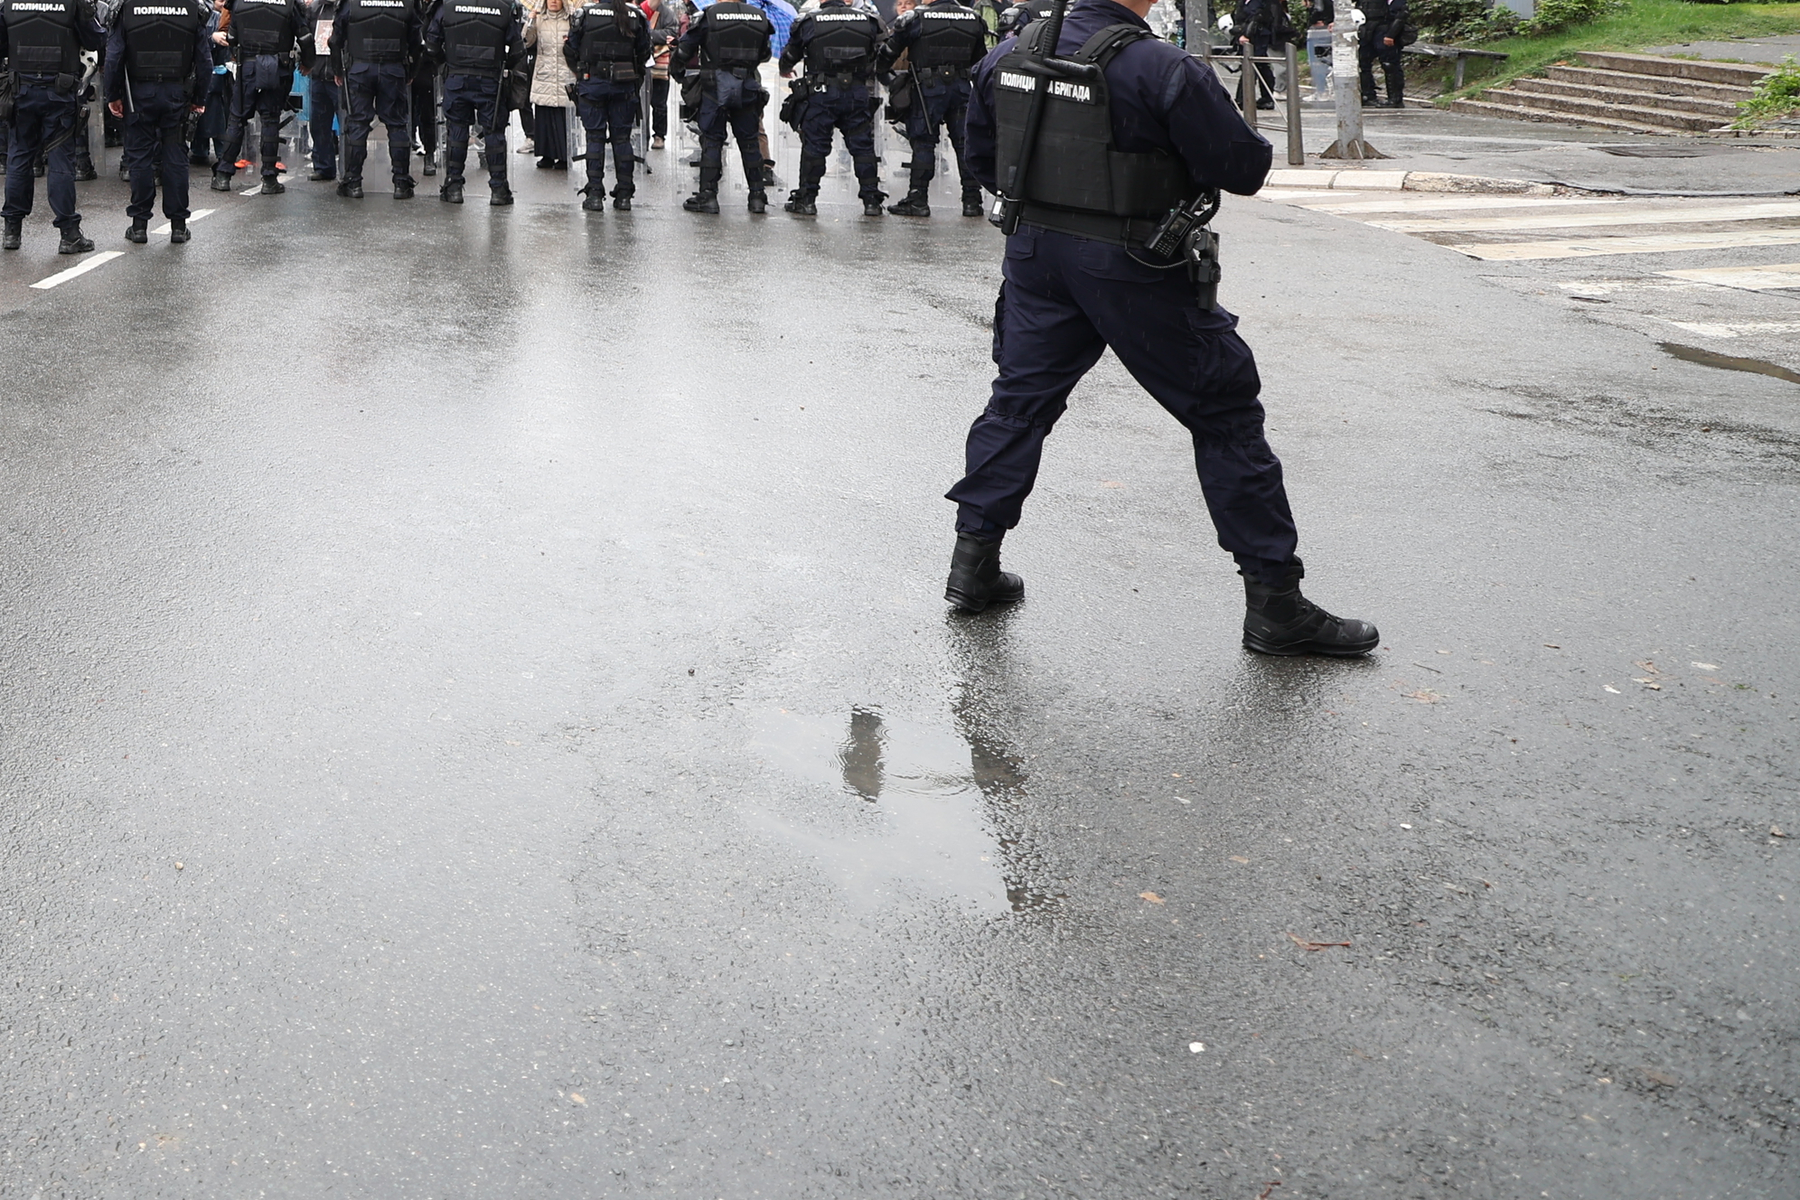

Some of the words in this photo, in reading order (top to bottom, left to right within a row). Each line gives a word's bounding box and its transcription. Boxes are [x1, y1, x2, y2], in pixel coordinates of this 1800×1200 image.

[11, 2, 66, 12] ПОЛИЦИЈА
[360, 0, 404, 8] ПОЛИЦИЈА
[133, 6, 188, 16] ПОЛИЦИЈА
[454, 5, 501, 16] ПОЛИЦИЈА
[715, 12, 763, 21] ПОЛИЦИЈА
[815, 13, 868, 22] ПОЛИЦИЈА
[923, 11, 976, 21] ПОЛИЦИЈА
[1054, 82, 1090, 102] БРИГАДА
